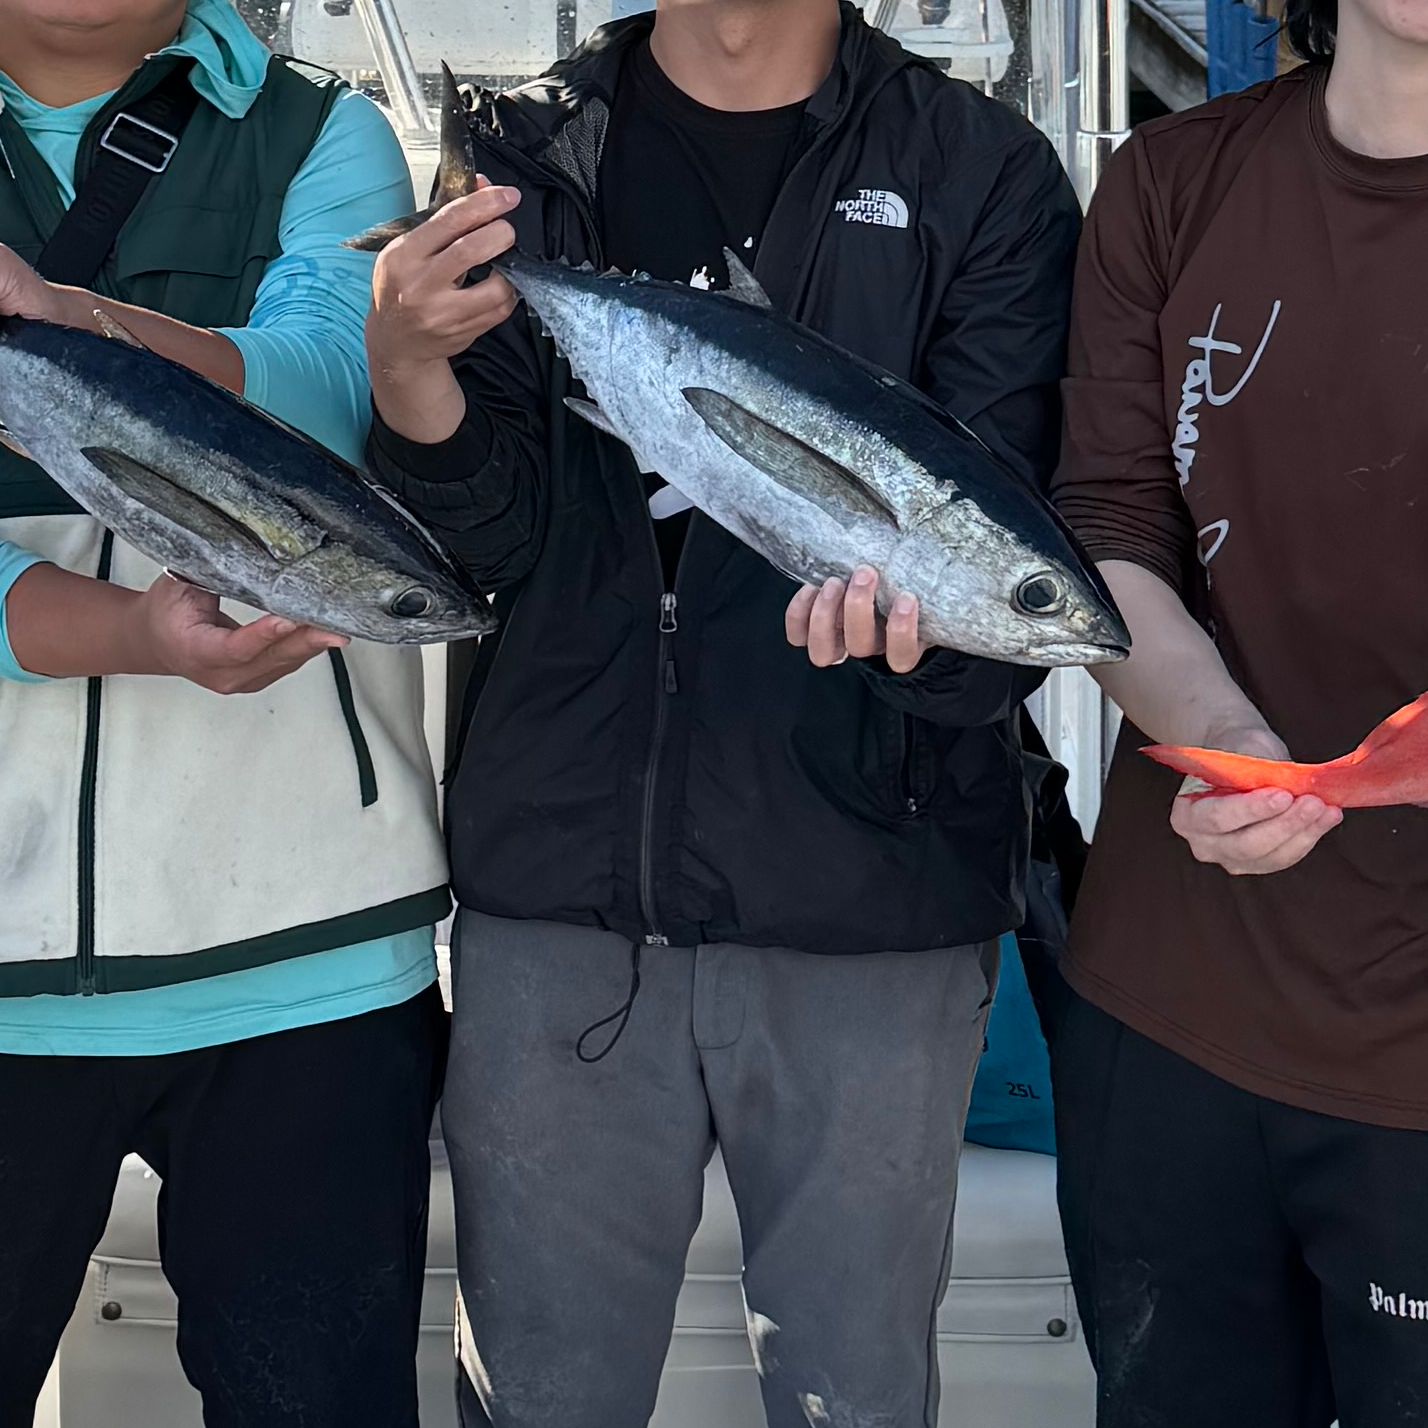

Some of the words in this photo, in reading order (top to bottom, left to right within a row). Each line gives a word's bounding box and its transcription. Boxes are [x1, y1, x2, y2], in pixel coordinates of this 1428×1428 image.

[858, 188, 886, 202] THE
[835, 199, 884, 213] NORTH
[845, 211, 883, 225] FACE
[1005, 1081, 1041, 1099] 25L
